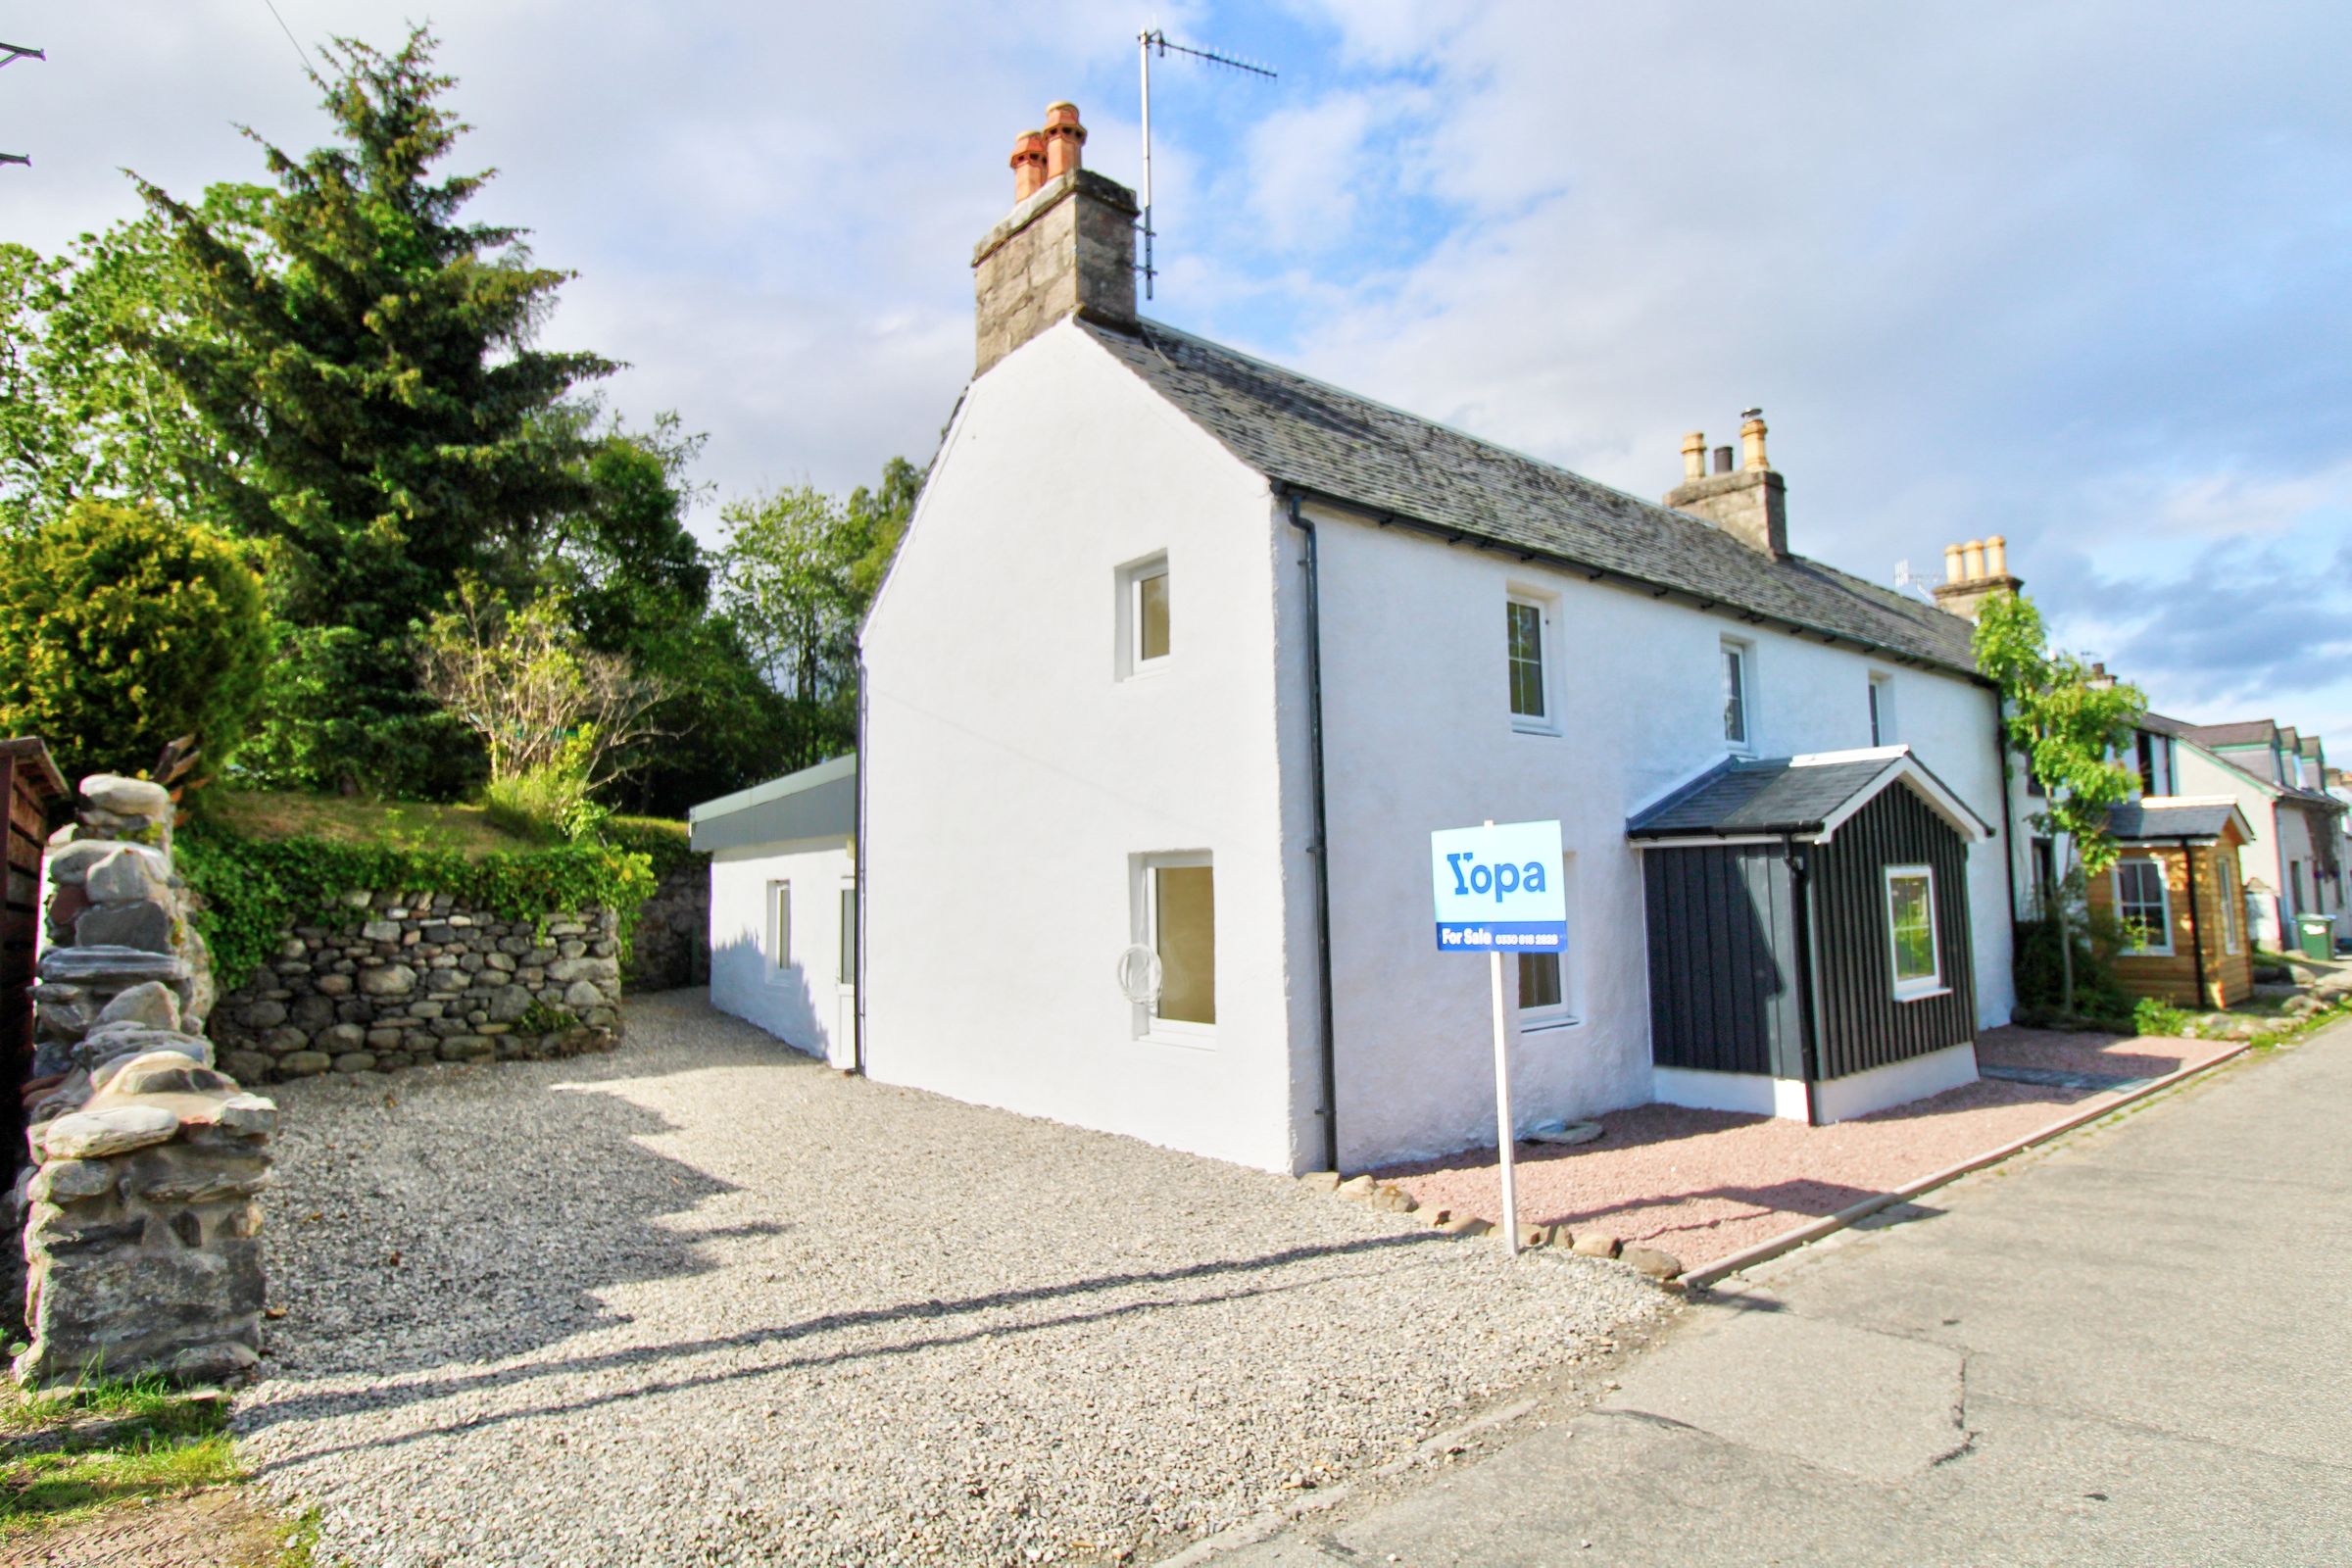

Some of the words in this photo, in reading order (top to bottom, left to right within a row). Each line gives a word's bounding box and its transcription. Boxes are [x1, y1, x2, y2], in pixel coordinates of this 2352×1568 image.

[1446, 852, 1546, 903] Yopa
[1442, 928, 1462, 945] For
[1463, 927, 1492, 946] Sale
